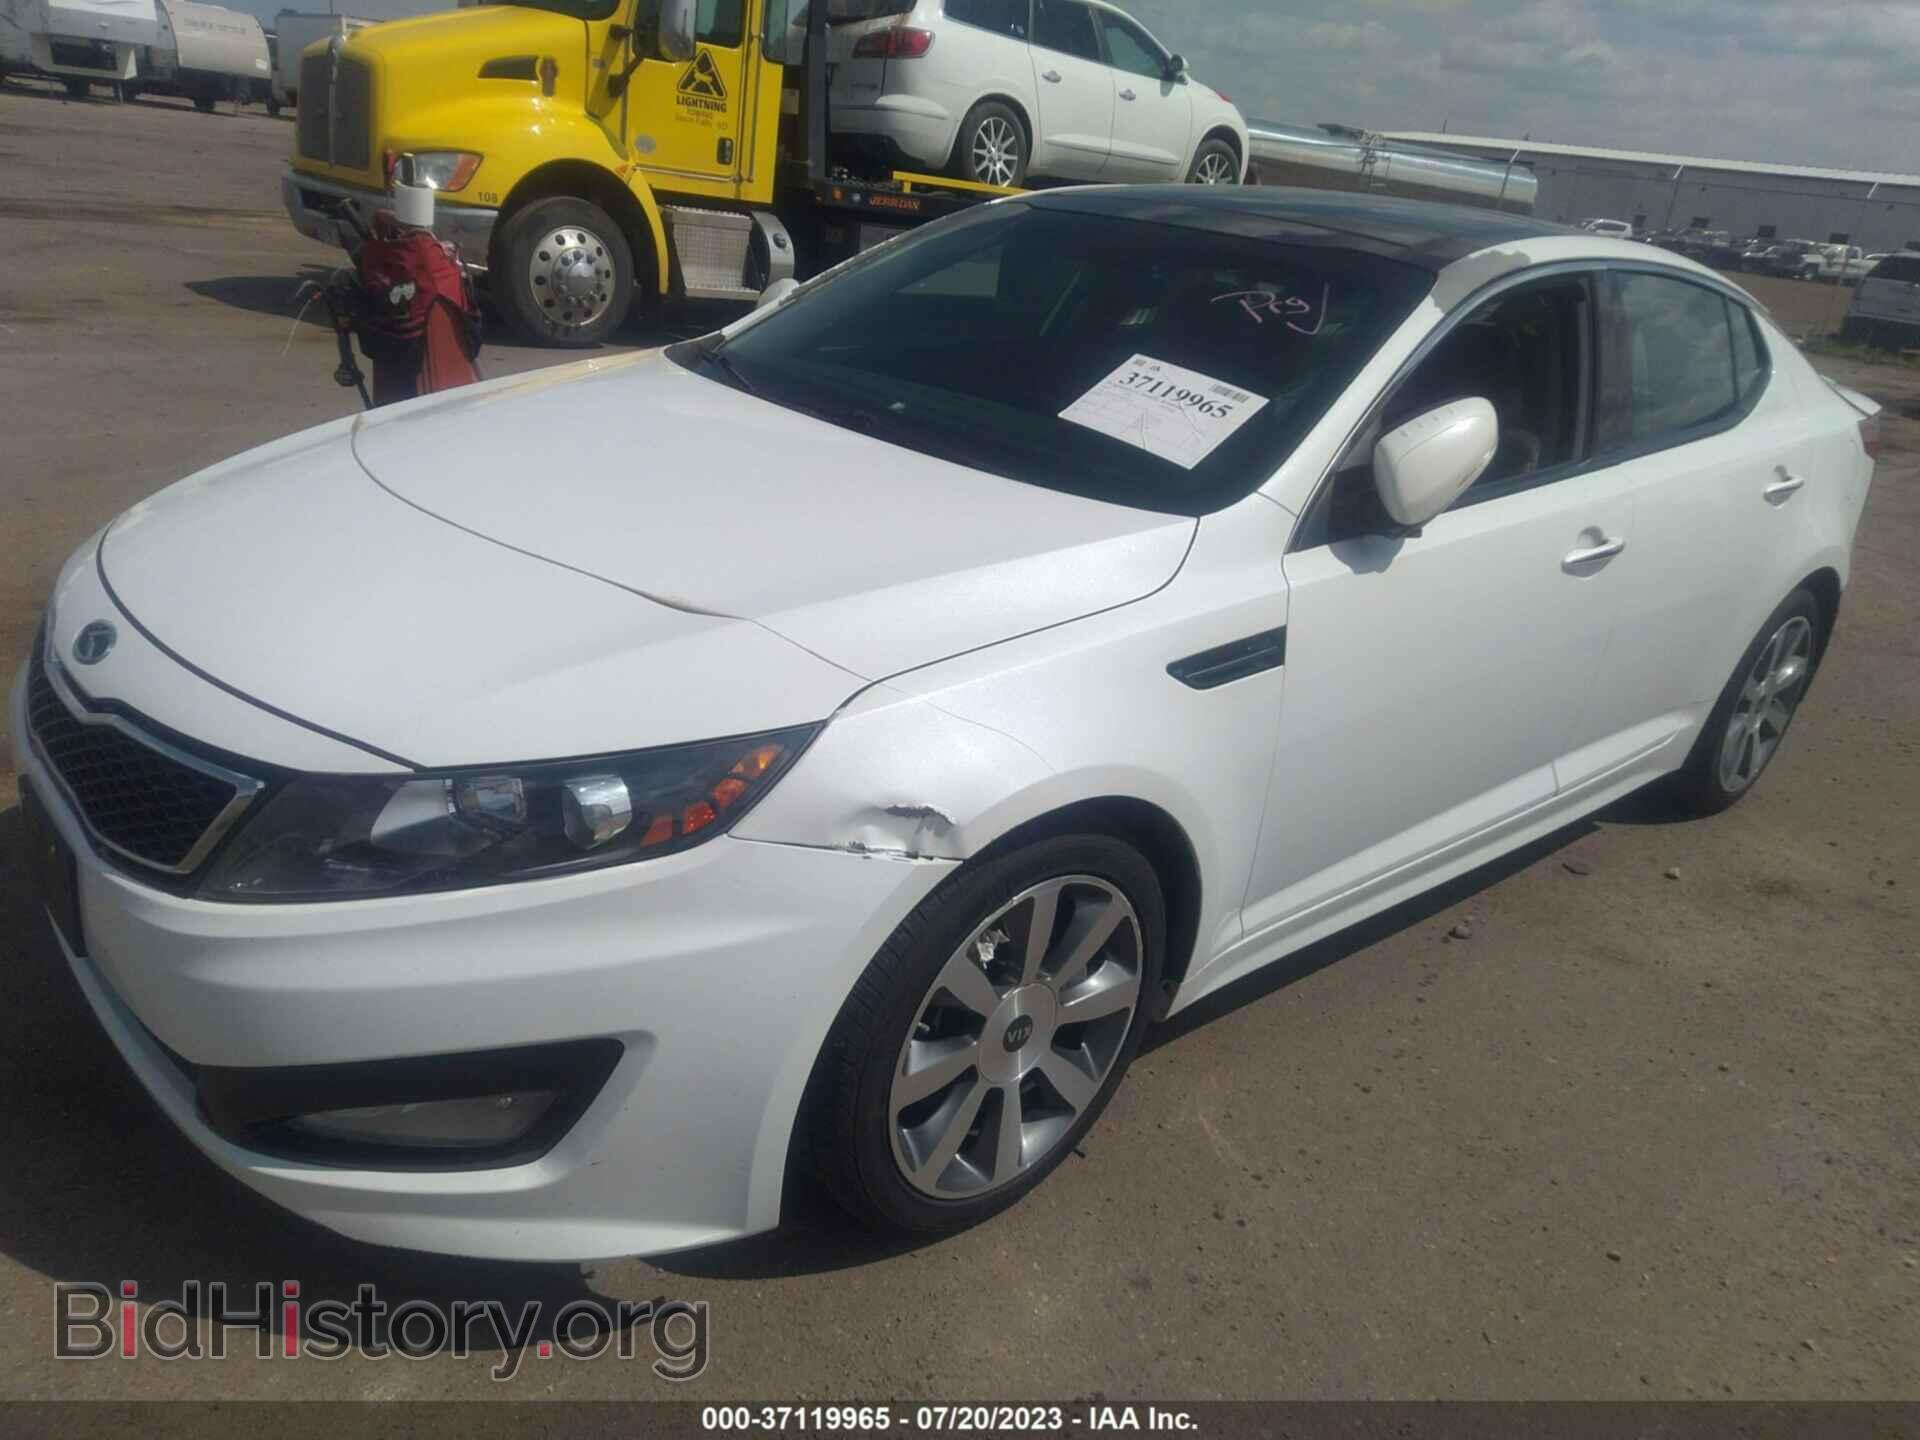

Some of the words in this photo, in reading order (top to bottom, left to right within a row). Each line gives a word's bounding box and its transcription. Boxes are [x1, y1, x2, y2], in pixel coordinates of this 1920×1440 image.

[676, 95, 728, 113] LIGHTNING
[477, 191, 499, 204] 108
[1118, 371, 1235, 420] 37119965
